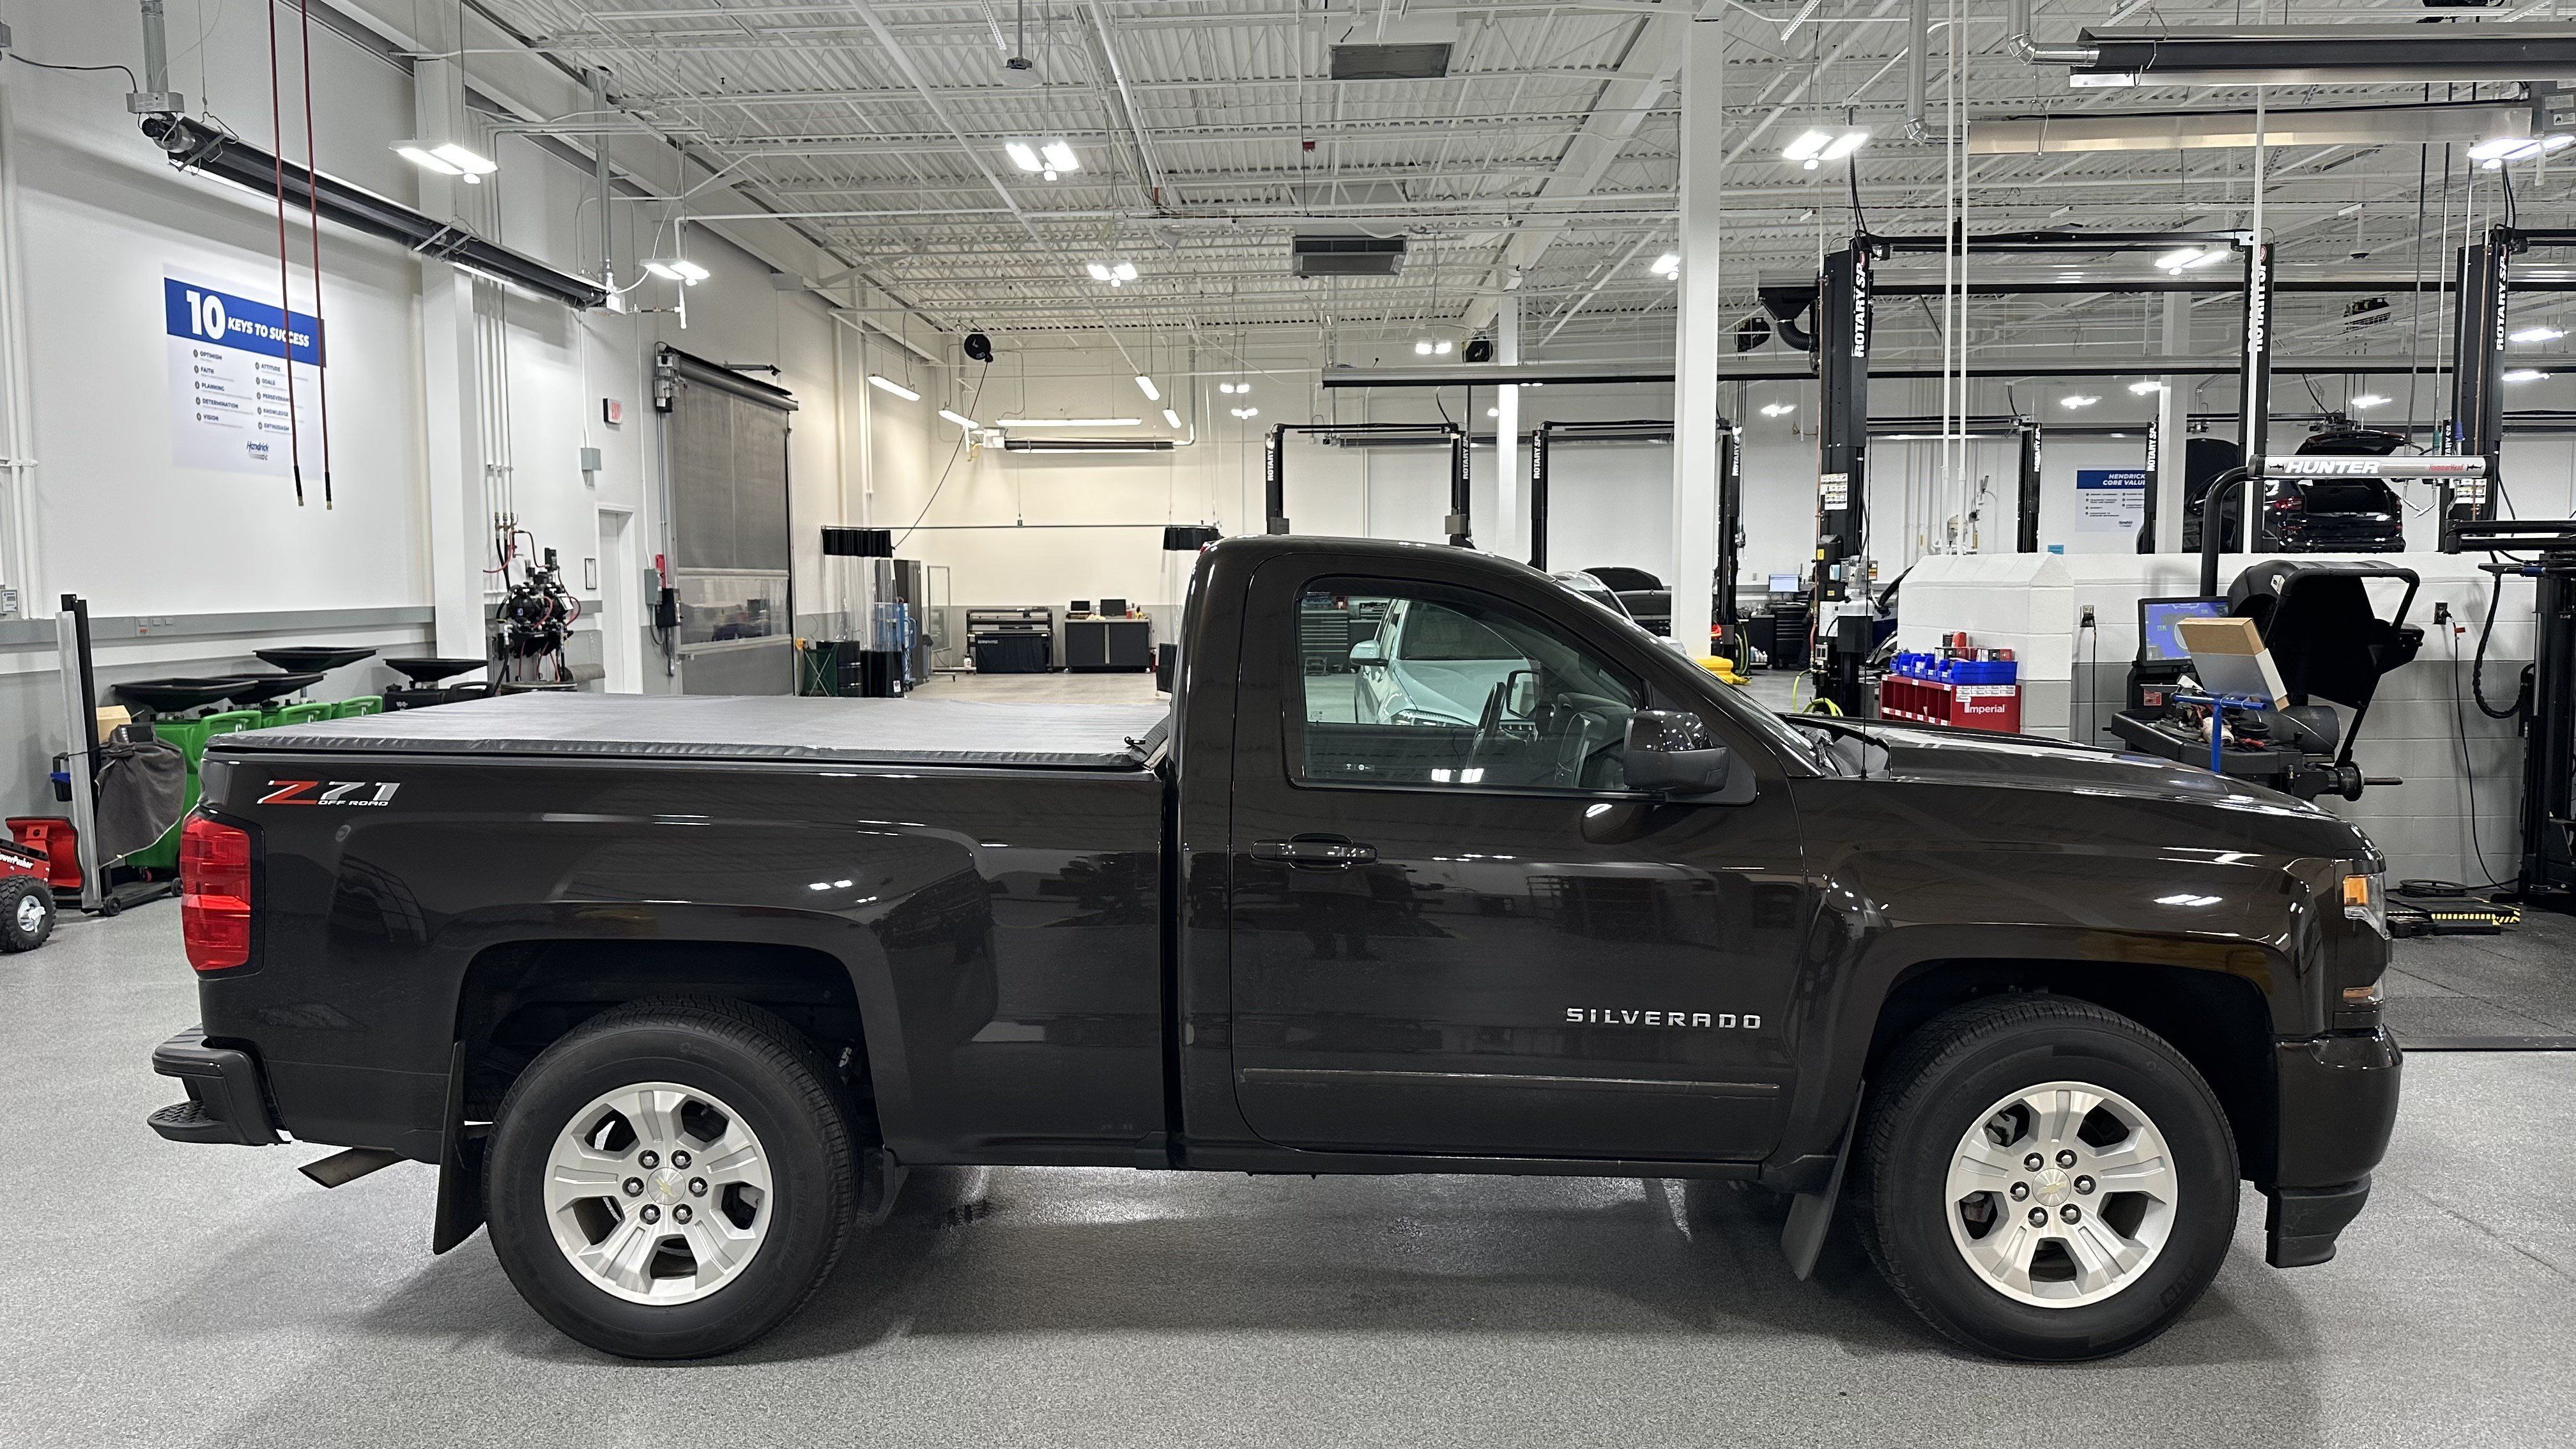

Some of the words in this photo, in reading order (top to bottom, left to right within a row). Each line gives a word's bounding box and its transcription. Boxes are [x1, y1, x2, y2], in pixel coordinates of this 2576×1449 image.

[1855, 263, 1866, 288] SP
[2499, 256, 2506, 281] SP
[186, 289, 226, 340] 10
[227, 317, 253, 334] KEYS
[255, 323, 268, 337] TO
[270, 327, 309, 347] SUCCESS
[1854, 288, 1865, 357] ROTARY
[2496, 282, 2506, 351] ROTARY
[247, 440, 269, 452] Hendrick
[2147, 440, 2156, 471] ROTARY
[2284, 461, 2381, 474] HUNTER
[1964, 702, 2005, 715] Imperial
[257, 780, 401, 804] Z71
[0, 853, 34, 869] owerPusher
[1566, 1008, 1761, 1029] SILVERADO
